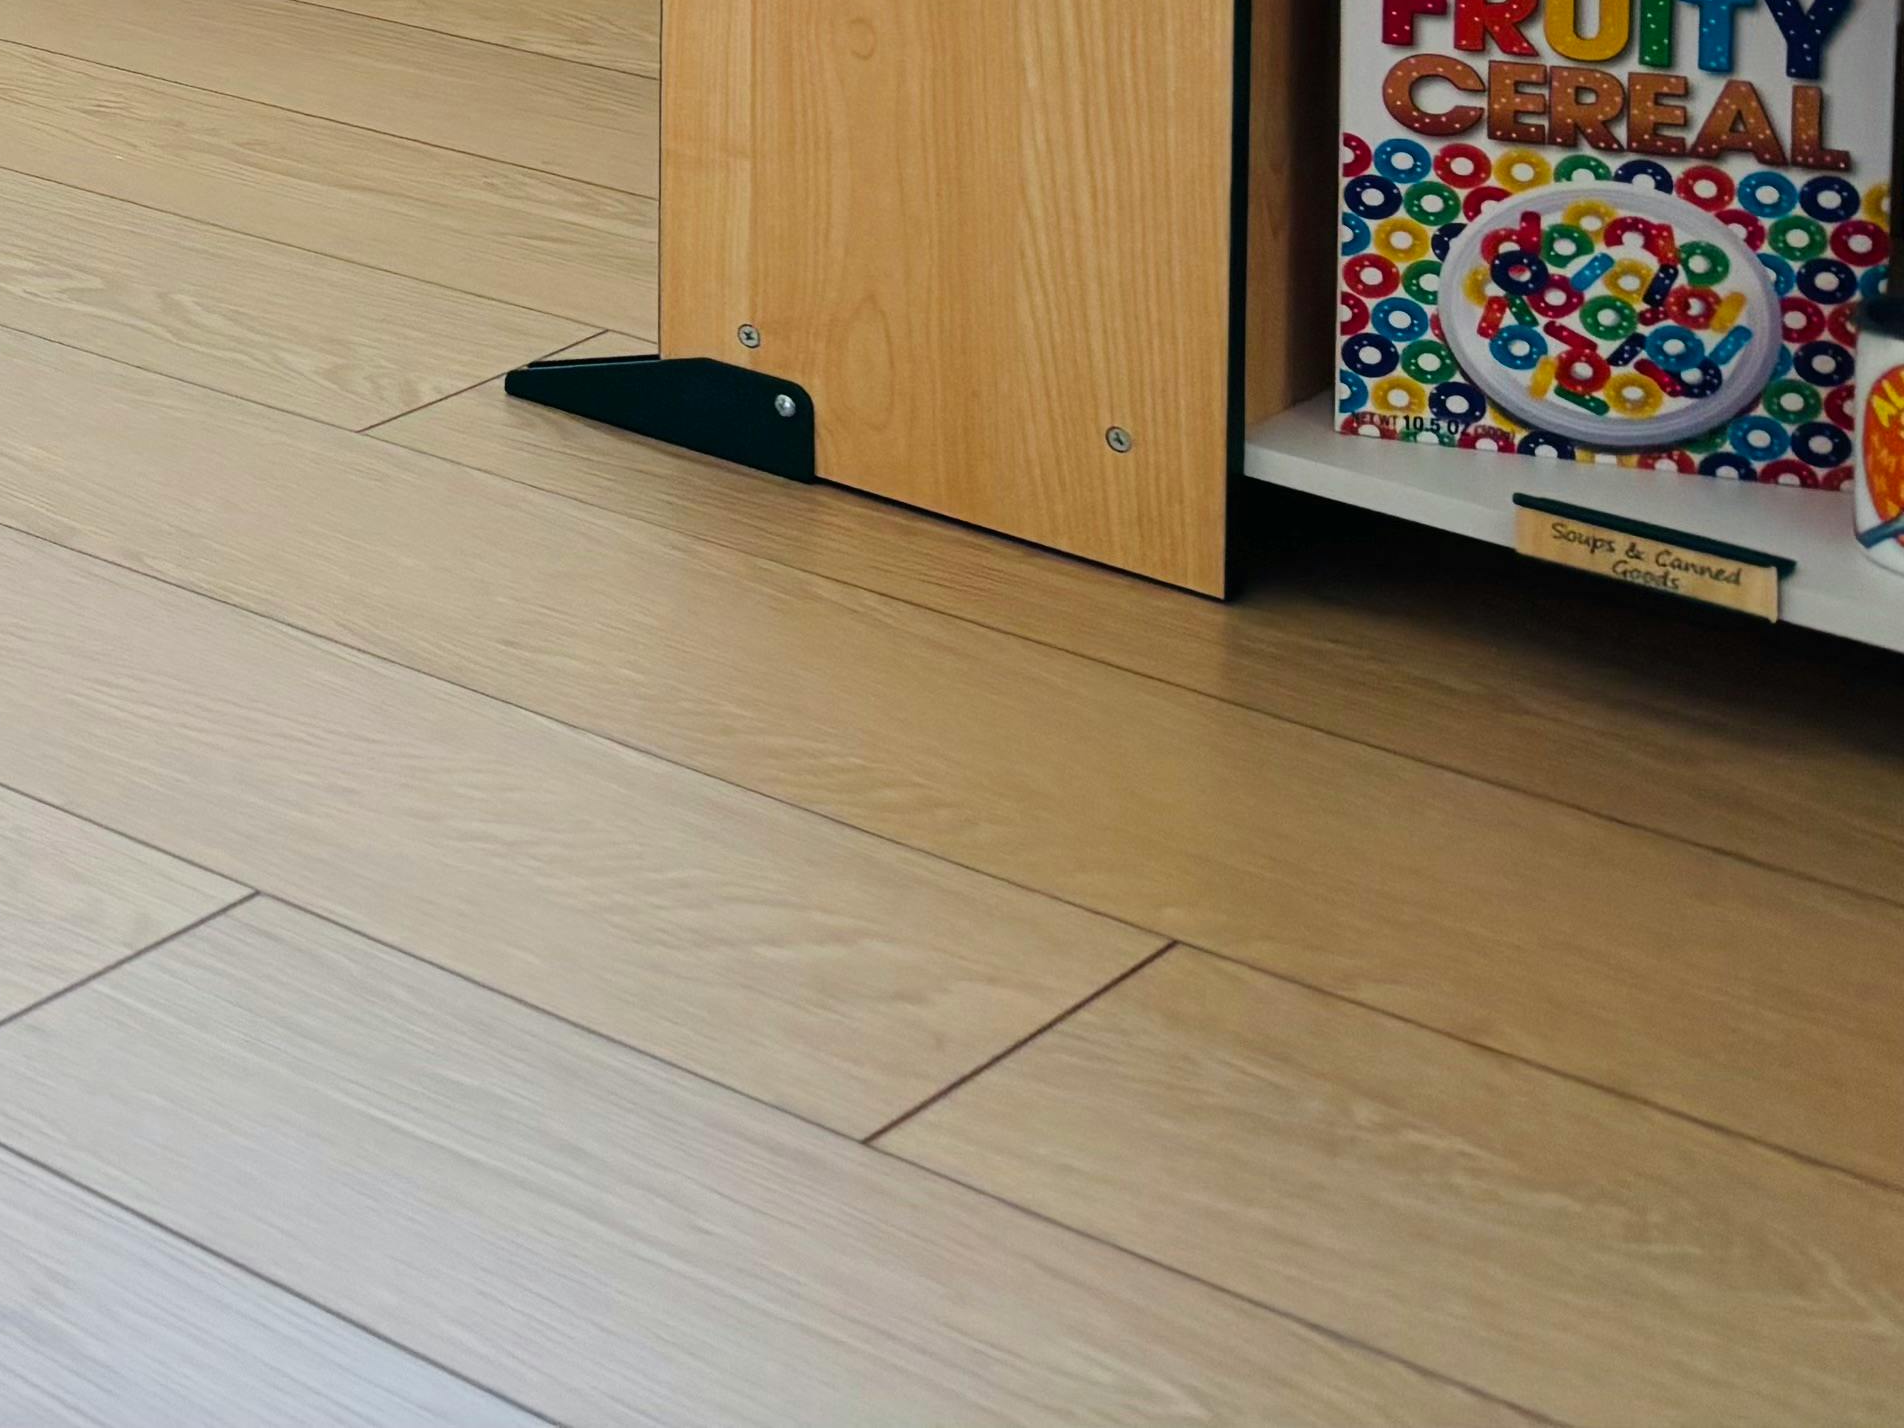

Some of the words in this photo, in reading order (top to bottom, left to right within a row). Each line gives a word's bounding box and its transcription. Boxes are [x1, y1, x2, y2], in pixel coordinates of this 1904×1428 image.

[1381, 53, 1852, 171] CEREAL
[1551, 522, 1616, 555] Soups
[1625, 543, 1645, 561] &
[1655, 549, 1742, 586] Canned
[1612, 559, 1680, 591] Goods
